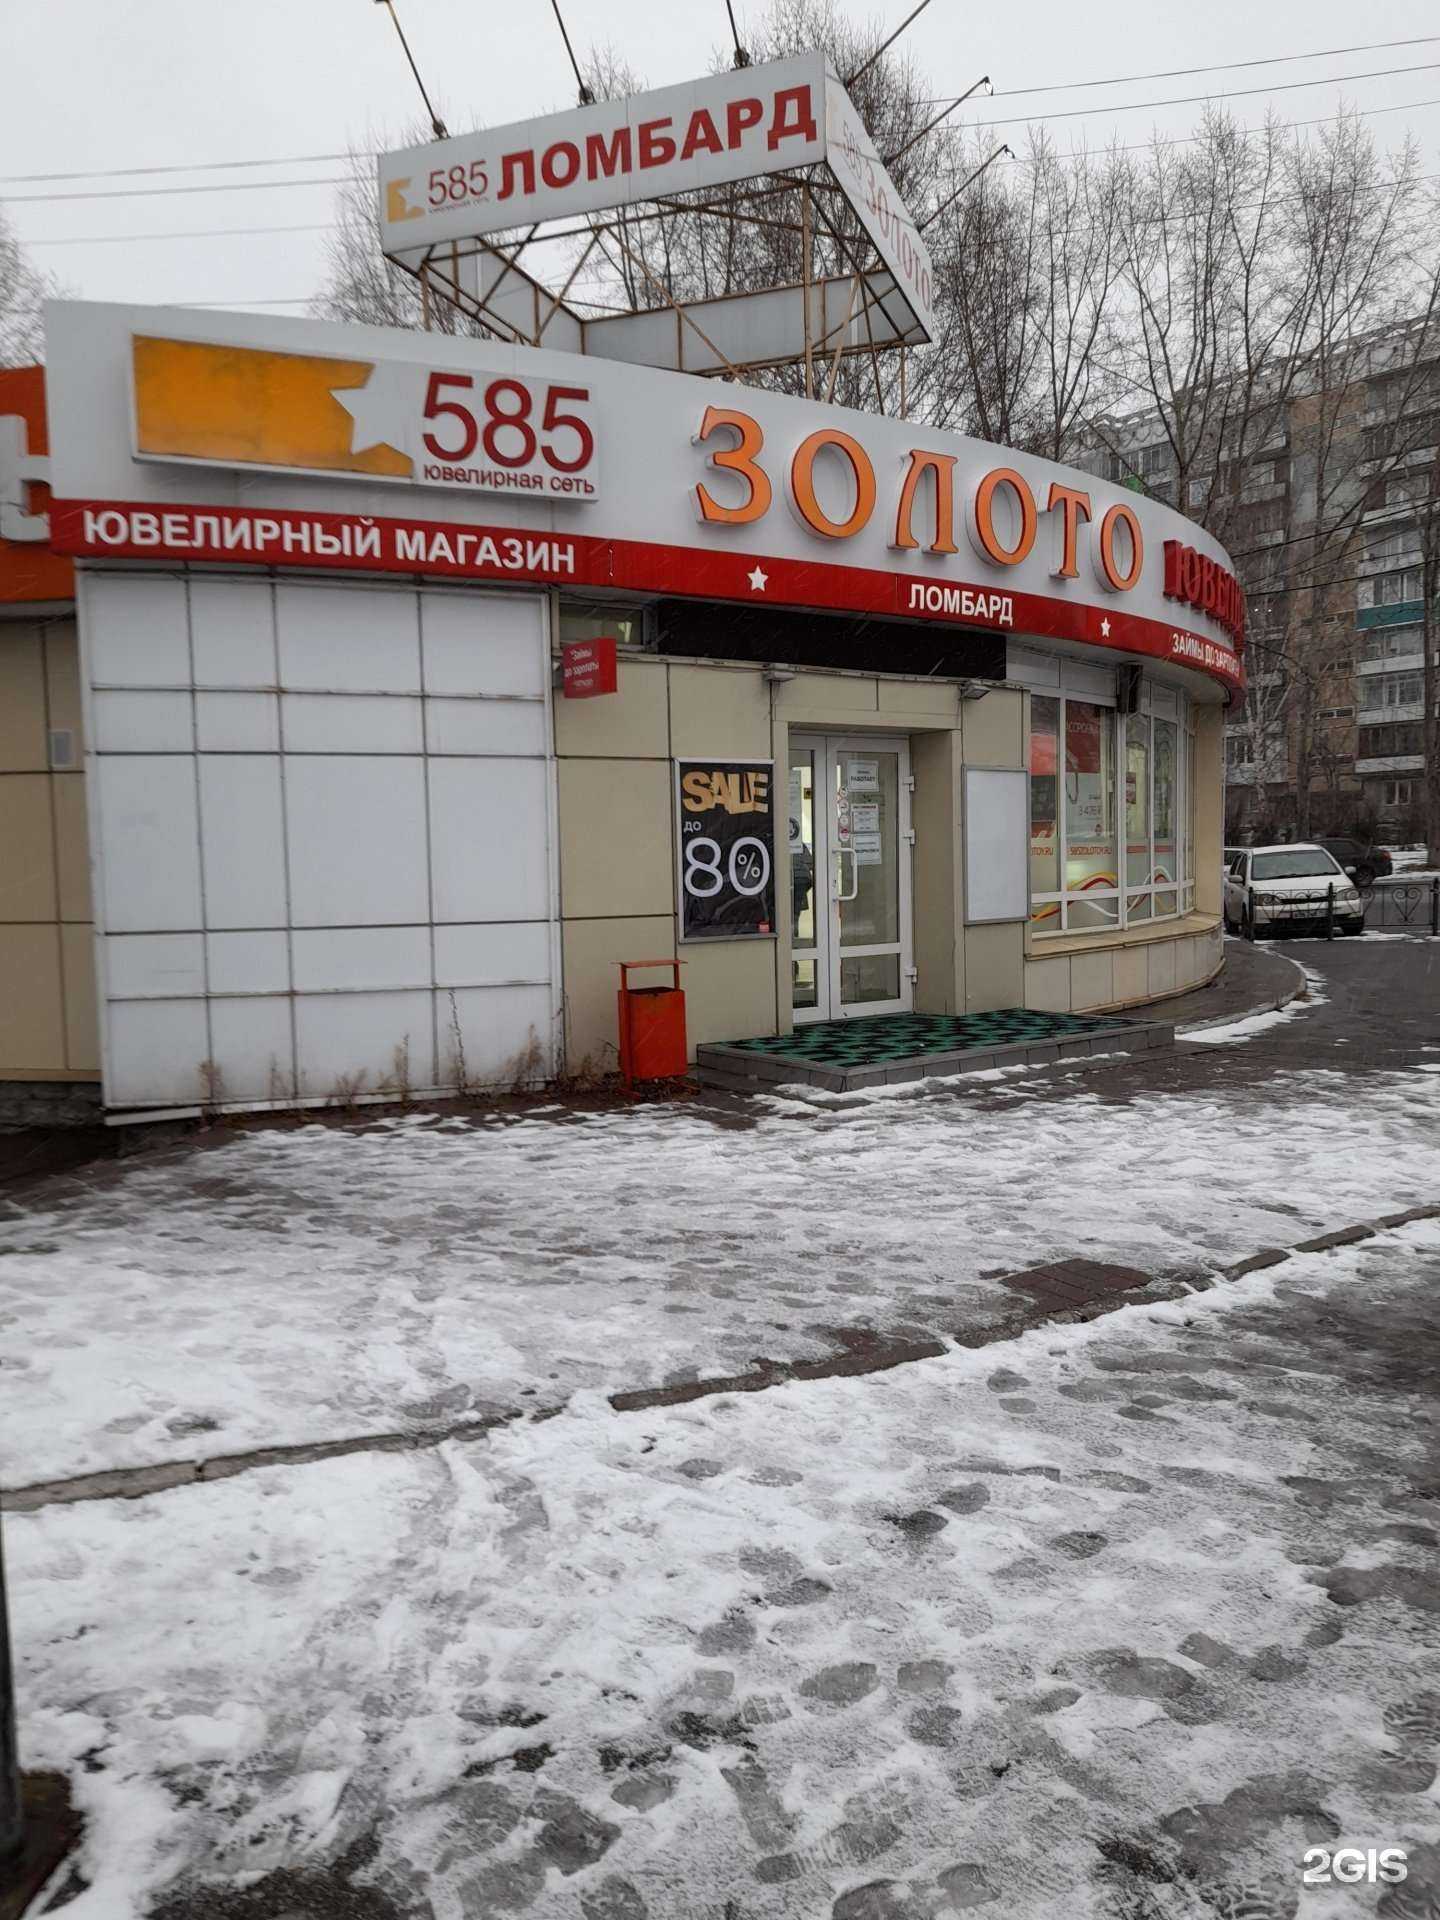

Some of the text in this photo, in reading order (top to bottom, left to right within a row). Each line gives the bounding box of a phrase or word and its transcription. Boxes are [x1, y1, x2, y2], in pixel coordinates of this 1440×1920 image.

[428, 85, 817, 206] 585 ЛОМБАРД
[865, 156, 932, 314] ЗОЛОТО
[423, 372, 594, 473] 585
[423, 463, 595, 495] ювелирная сеть
[694, 405, 1144, 592] ЗОЛОТО
[83, 510, 575, 574] ЮВЕЛИРНЫЙ МАГАЗИН
[908, 583, 1014, 626] ЛОМБАРД
[1172, 633, 1204, 662] ЗАЙМЫ
[682, 771, 769, 815] SALE
